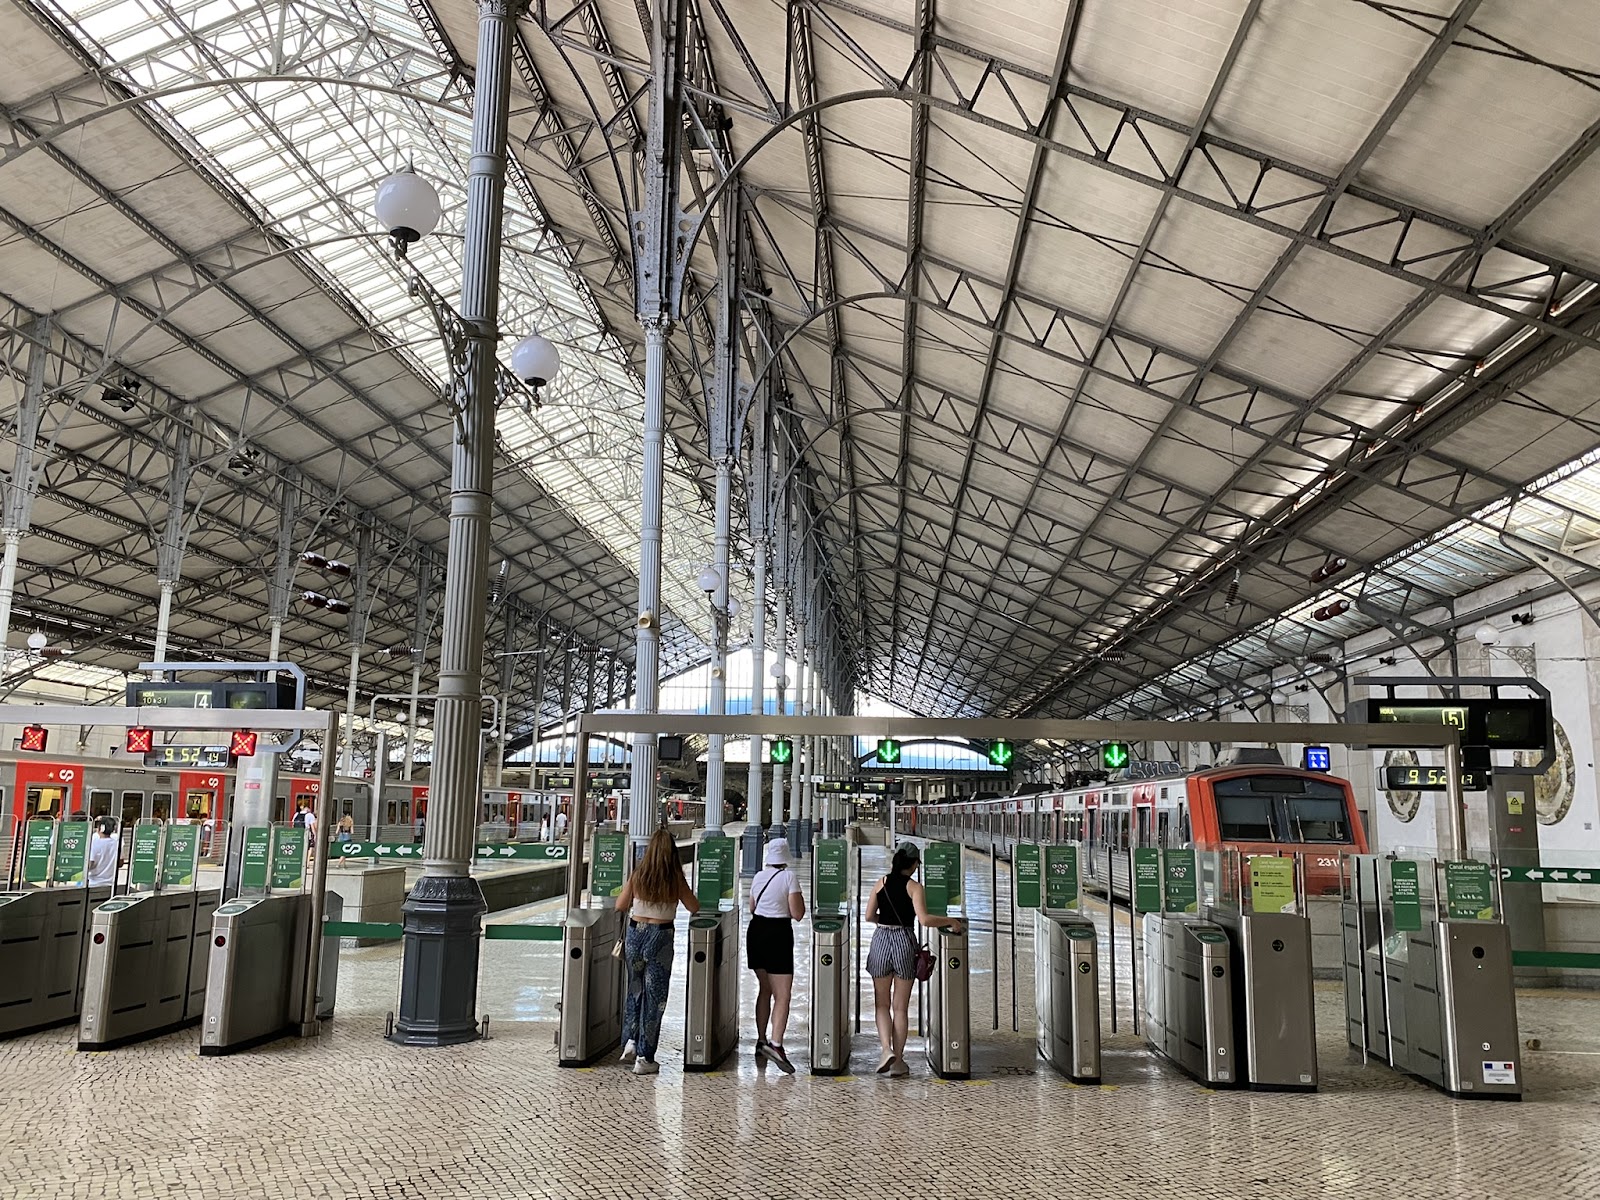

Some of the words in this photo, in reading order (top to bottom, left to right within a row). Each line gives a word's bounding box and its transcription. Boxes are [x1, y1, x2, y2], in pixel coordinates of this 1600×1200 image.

[198, 694, 209, 708] 4
[1449, 711, 1459, 725] 5
[164, 748, 174, 762] 9
[181, 748, 200, 762] 52
[1408, 770, 1419, 784] 9
